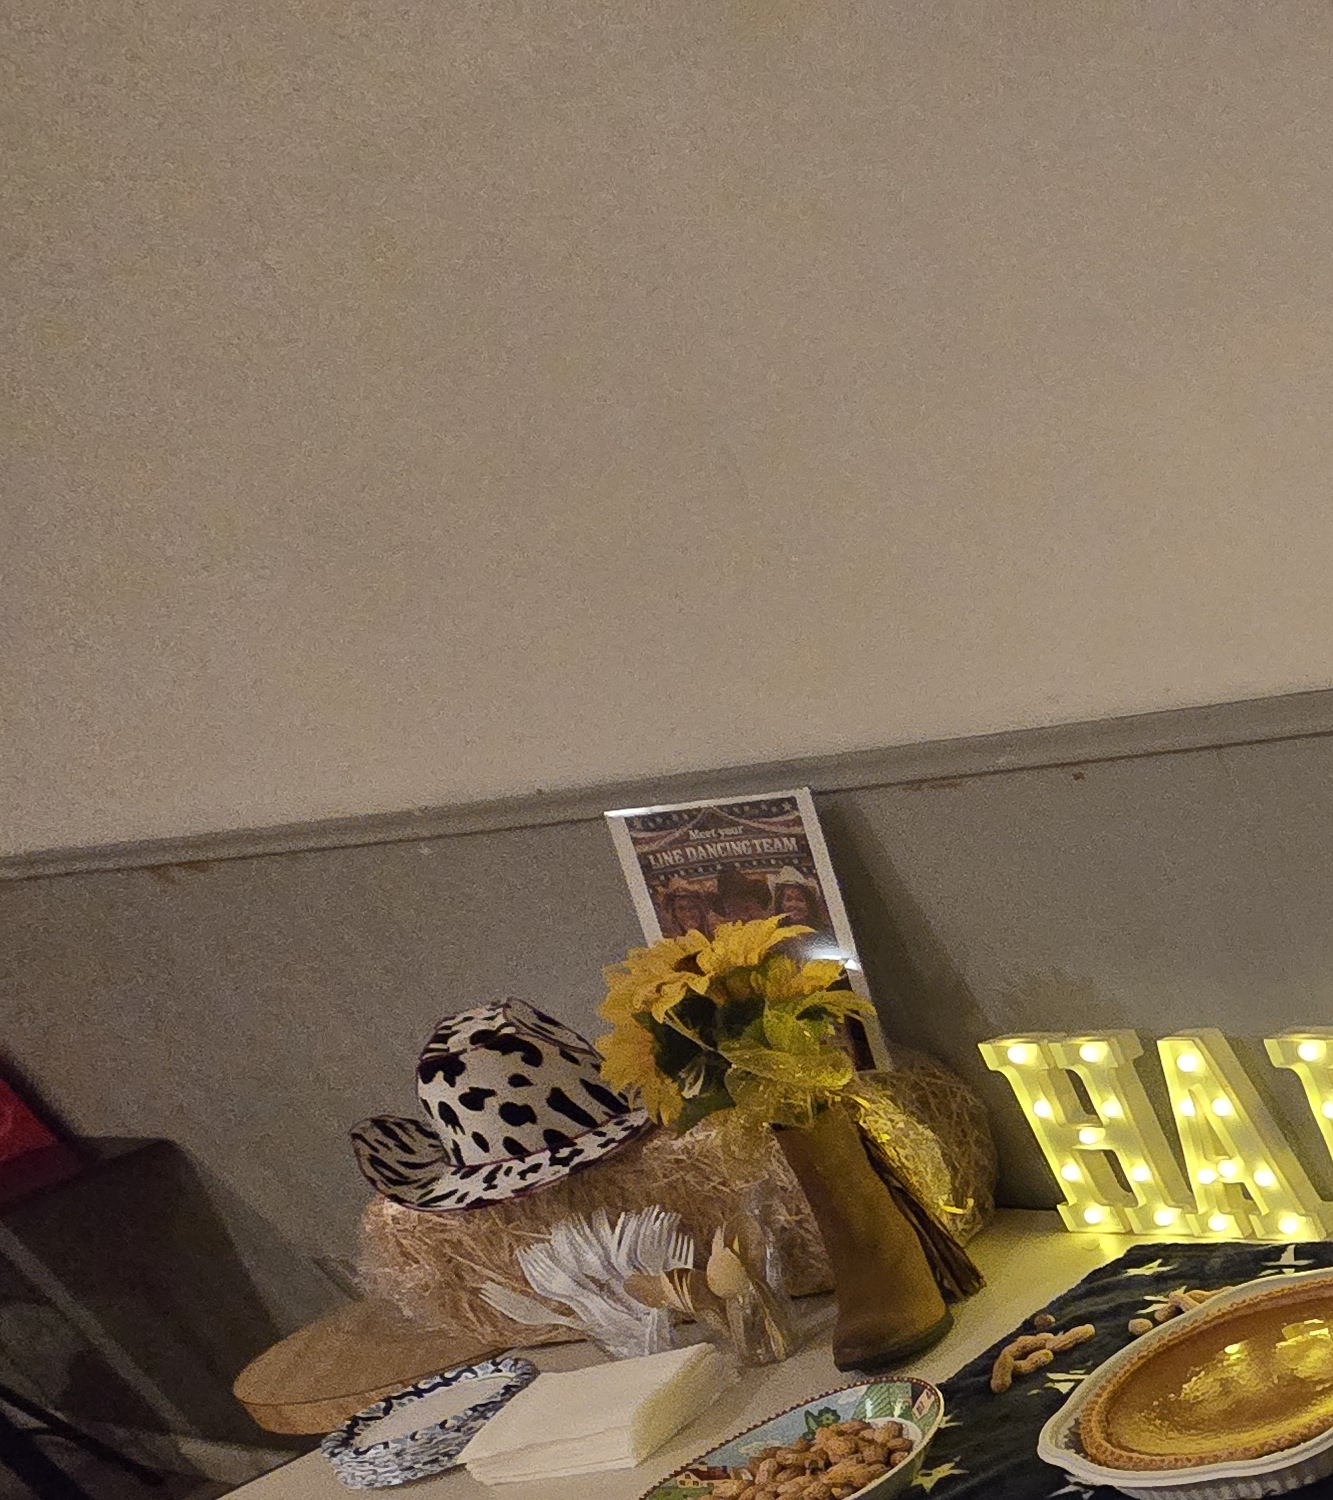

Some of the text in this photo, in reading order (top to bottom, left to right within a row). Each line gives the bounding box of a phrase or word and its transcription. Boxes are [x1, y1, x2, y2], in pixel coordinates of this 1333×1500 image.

[718, 825, 745, 840] your
[650, 837, 799, 870] LINE DANCING TEAM
